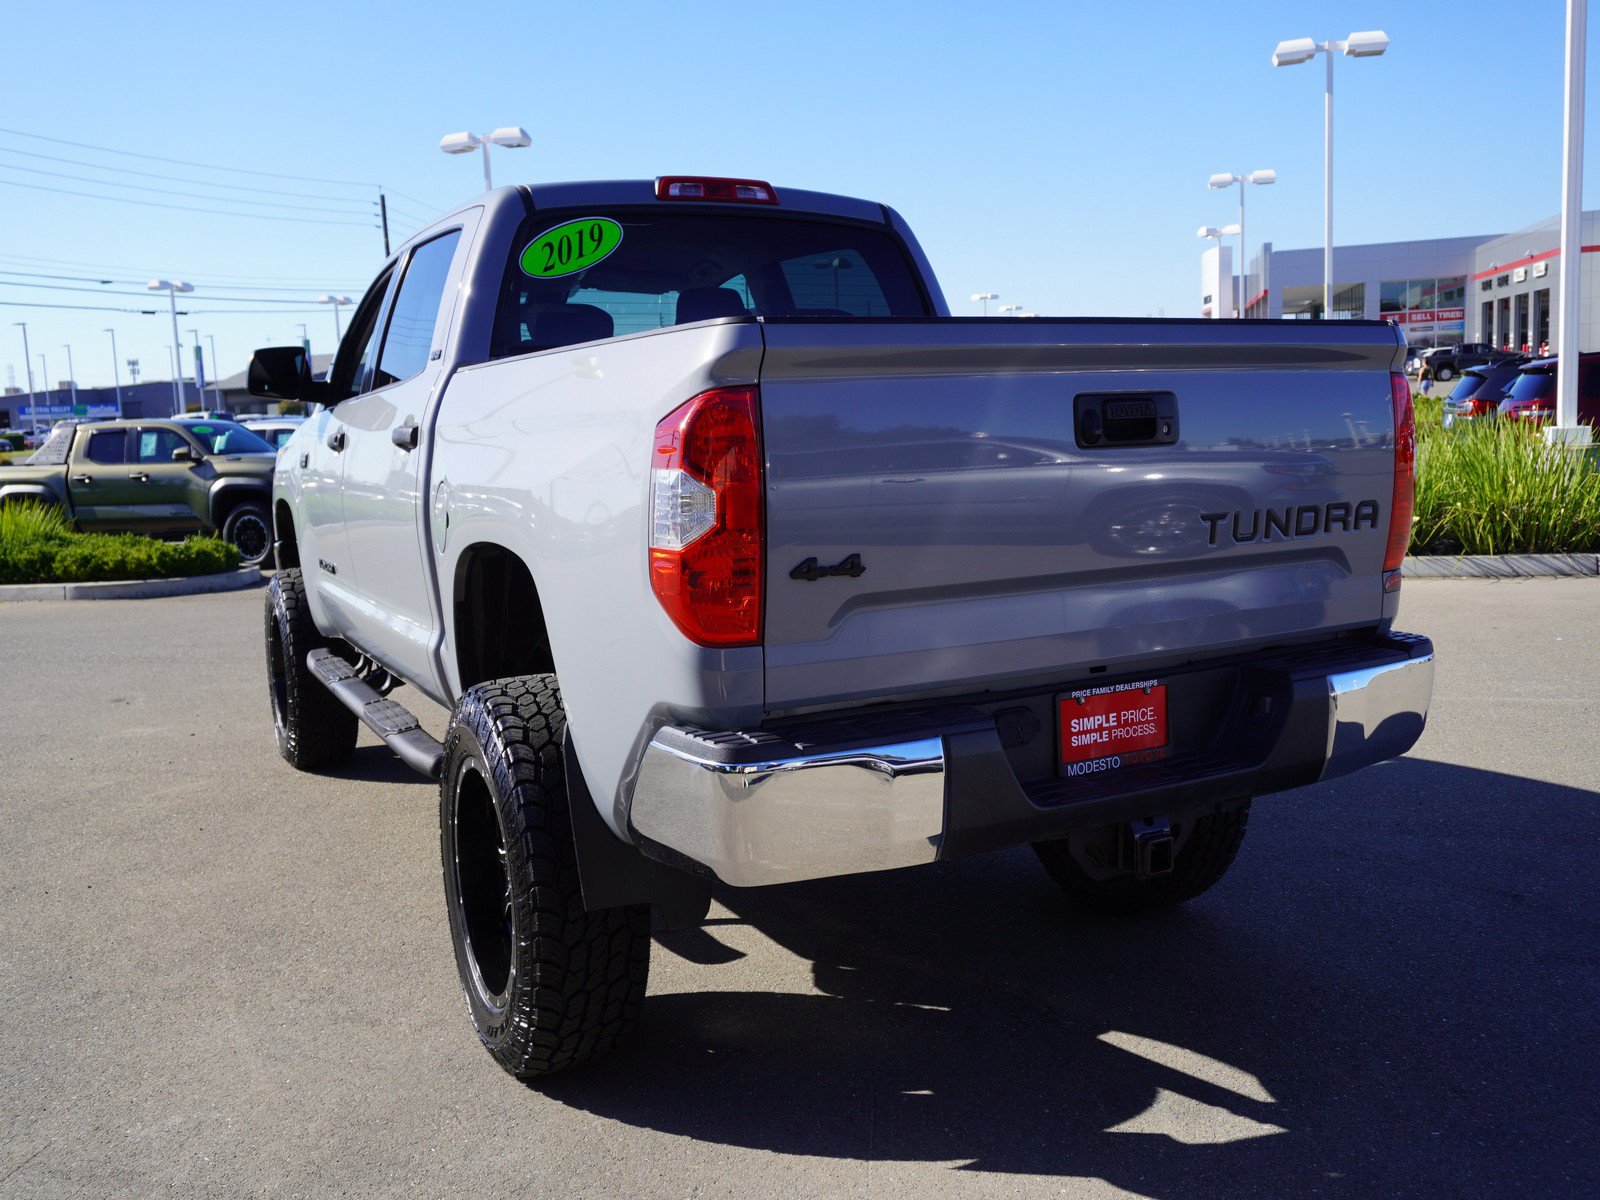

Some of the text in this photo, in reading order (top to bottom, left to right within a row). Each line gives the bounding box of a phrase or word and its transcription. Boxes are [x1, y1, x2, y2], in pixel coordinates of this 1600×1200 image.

[541, 222, 603, 273] 2019
[1438, 311, 1463, 319] TIRES!
[1109, 402, 1154, 417] TOYOTA
[1199, 499, 1380, 547] TUNDRA
[790, 553, 866, 581] 4x4
[1072, 679, 1158, 698] PRICE FAMILY DEALERSHIPS
[1071, 707, 1157, 732] SIMPLE PRICE.
[1071, 723, 1158, 747] SIMPLE PROCESS.
[1067, 749, 1166, 777] MODESTO TOYOTA
